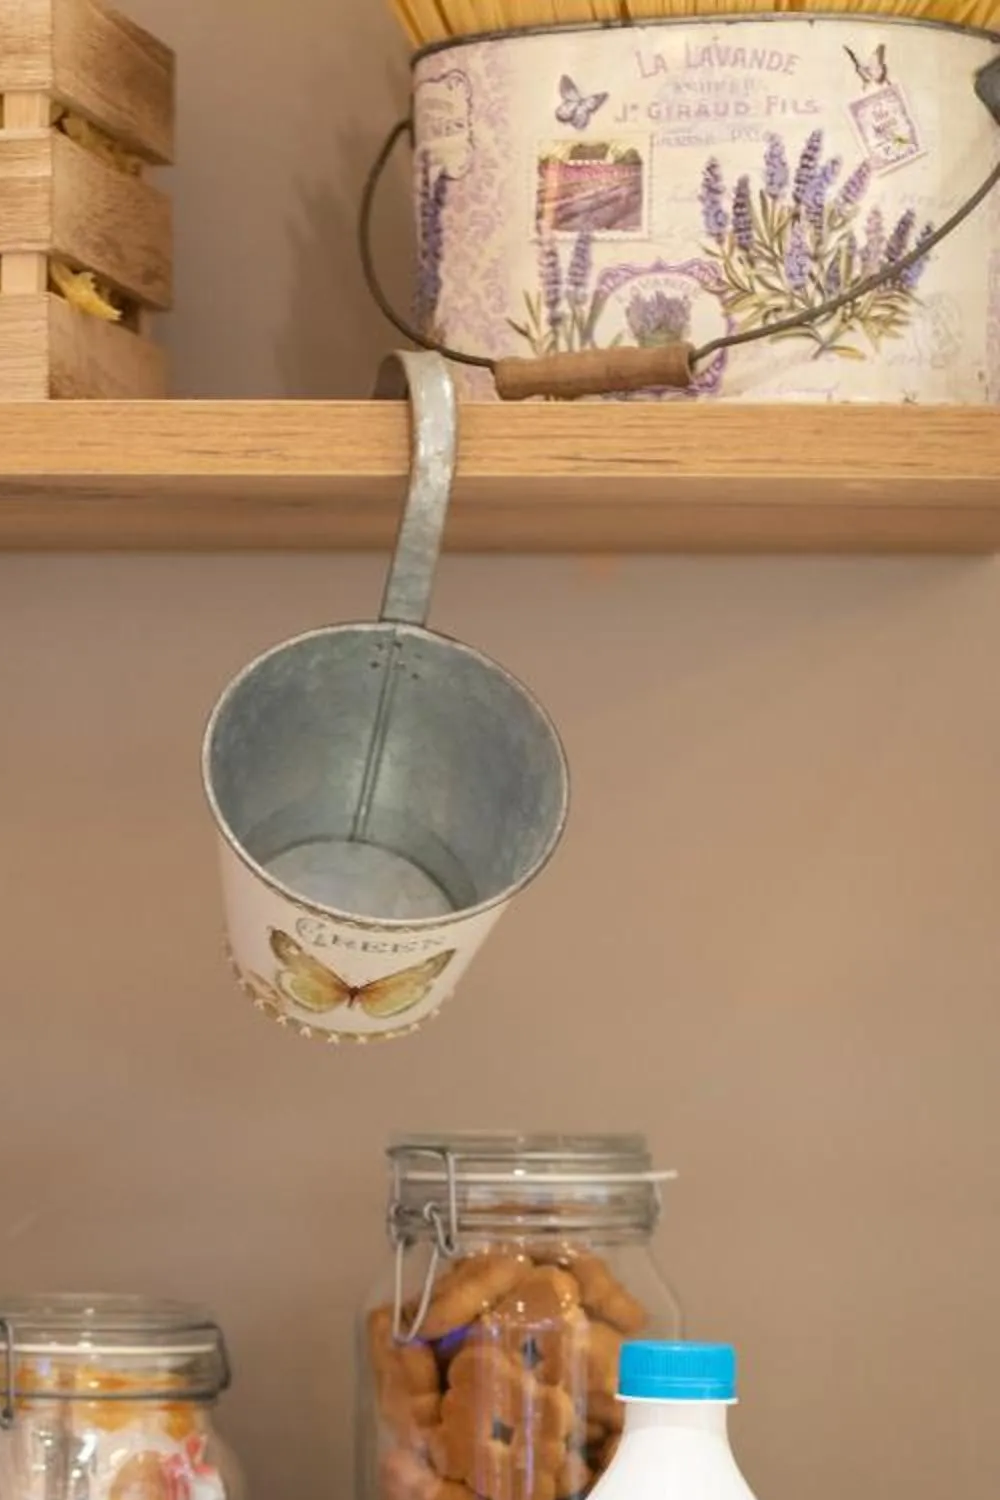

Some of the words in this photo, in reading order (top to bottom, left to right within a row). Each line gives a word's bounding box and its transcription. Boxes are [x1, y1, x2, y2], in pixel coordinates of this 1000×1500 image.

[636, 50, 667, 79] LA
[685, 43, 800, 76] LAVANDE
[647, 100, 751, 121] GIRAUD
